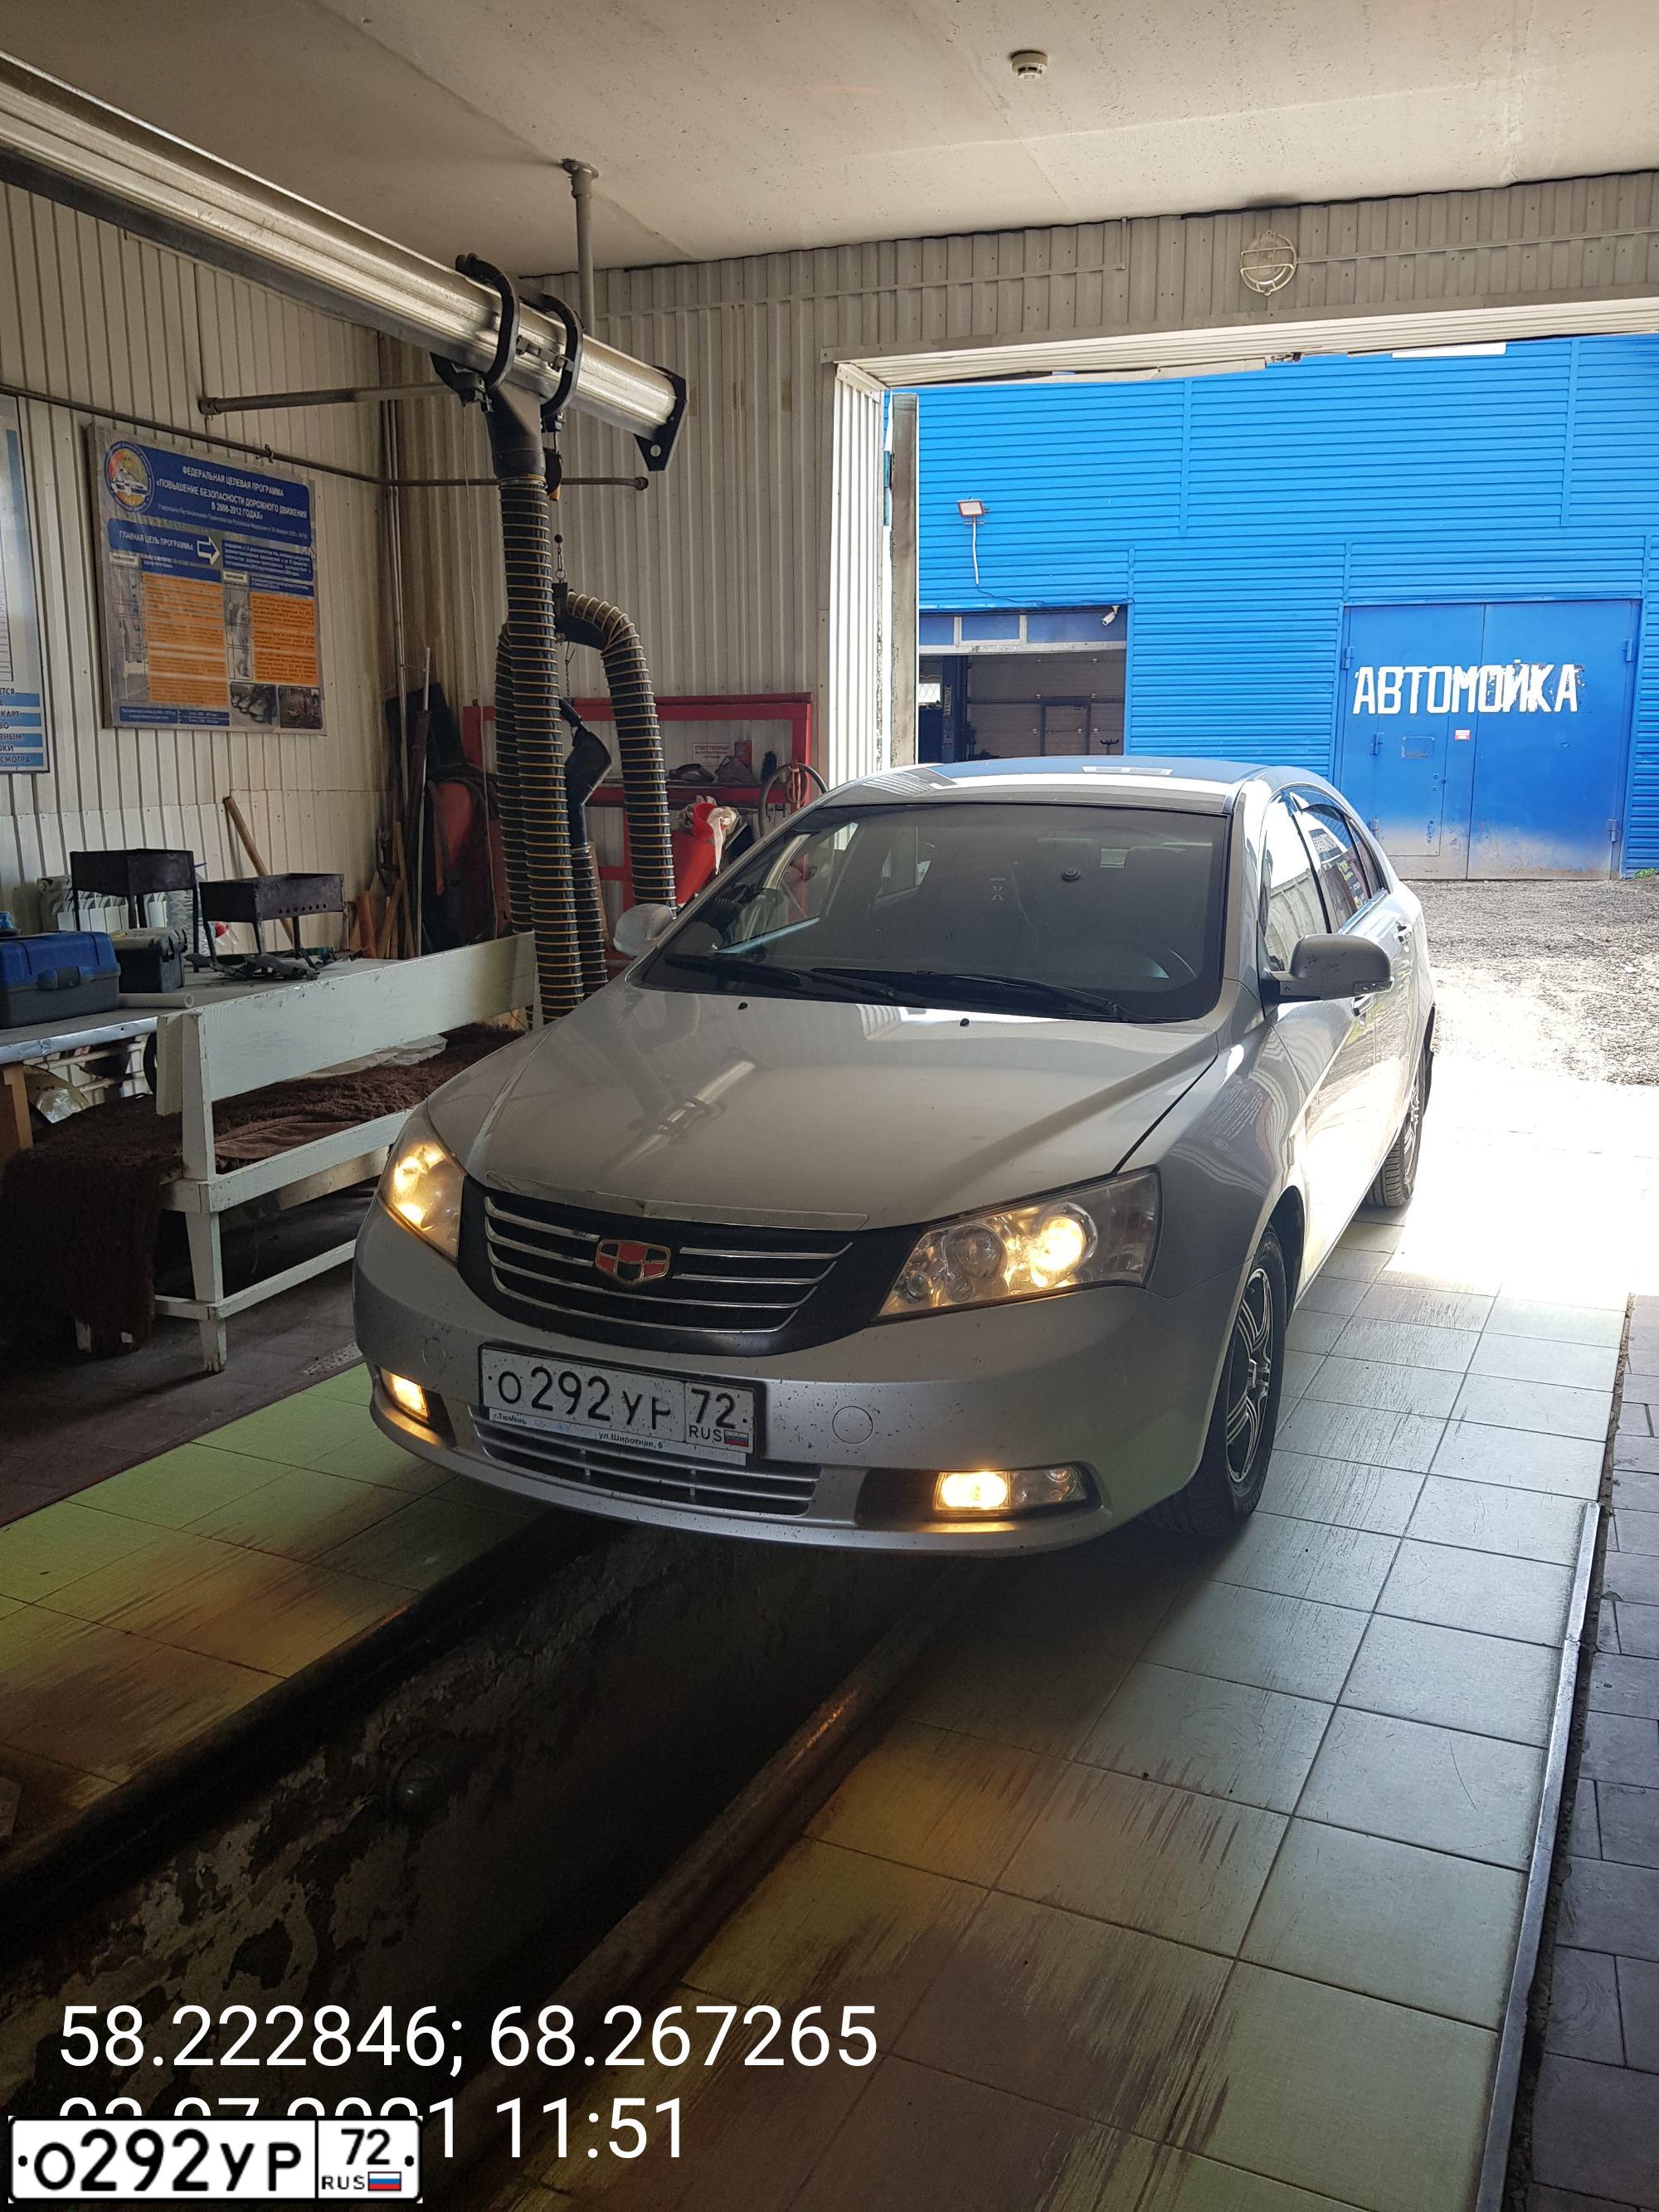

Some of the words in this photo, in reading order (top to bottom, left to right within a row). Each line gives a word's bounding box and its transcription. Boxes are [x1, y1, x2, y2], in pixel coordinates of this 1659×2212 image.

[182, 465, 225, 484] ФЕДЕРАЛЬНАЯ
[226, 476, 251, 490] ЦЕЛЕВАЯ
[251, 482, 284, 497] ПРОГРАММА
[200, 487, 245, 505] БЕЗОПАСНОСТИ
[245, 498, 279, 513] ДОРОЖНОГО
[279, 505, 307, 519] ДВИЖЕНИЯ
[119, 530, 144, 542] ГЛАВНАЯ
[144, 534, 160, 545] ЦЕЛЬ
[1352, 659, 1579, 714] АВТОМОЙКА
[499, 1367, 671, 1430] О292УР
[691, 1388, 737, 1429] 72
[689, 1425, 722, 1442] RUS
